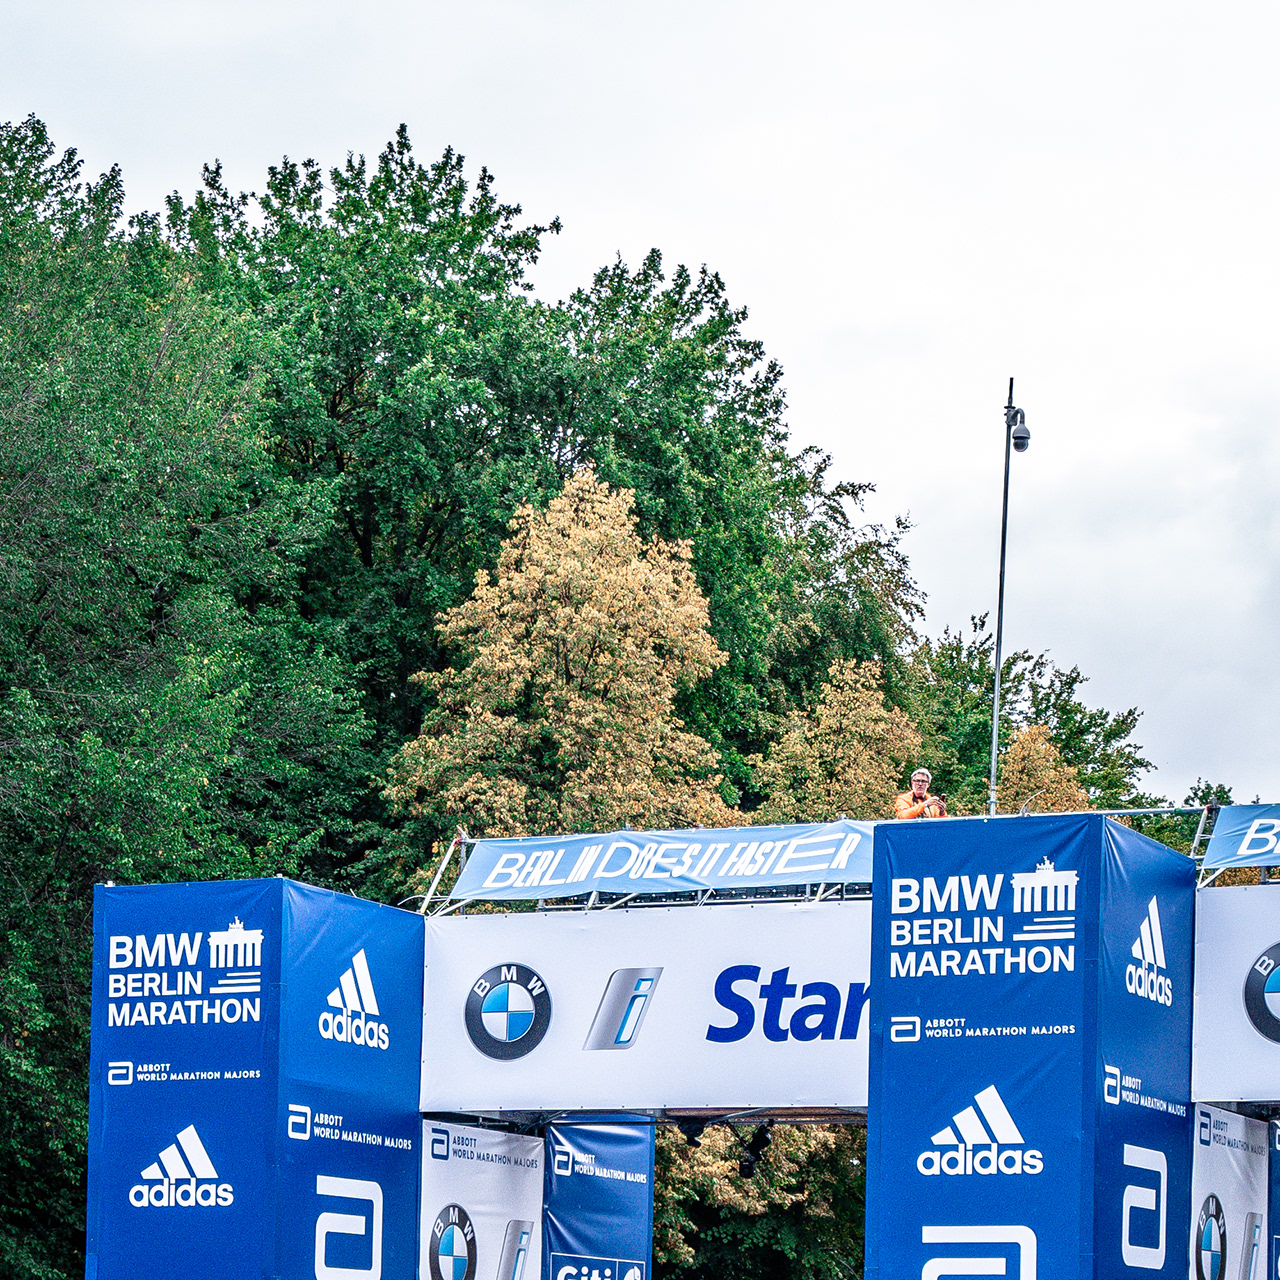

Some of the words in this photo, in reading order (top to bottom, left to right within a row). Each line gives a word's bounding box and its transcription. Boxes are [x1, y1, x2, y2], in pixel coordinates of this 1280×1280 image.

[482, 845, 604, 888] BERLIN
[594, 841, 701, 880] DOES
[693, 841, 733, 877] IT
[718, 832, 862, 877] FASTER
[891, 873, 1004, 914] BMW
[890, 916, 1003, 946] BERLIN
[108, 932, 203, 969] BMW
[890, 945, 1075, 978] MARATHON
[108, 971, 202, 998] BERLIN
[1125, 959, 1173, 1007] adidas
[108, 998, 261, 1027] MARATHON
[705, 964, 871, 1043] Star
[318, 1008, 390, 1050] adidas
[925, 1018, 966, 1028] ABBOTT
[925, 1028, 962, 1038] WORLD
[965, 1026, 1027, 1037] MARATHON
[1031, 1024, 1076, 1035] MAJORS
[136, 1063, 171, 1073] ABBOTT
[136, 1072, 168, 1081] WORLD
[170, 1070, 221, 1081] MARATHON
[224, 1070, 261, 1080] MAJORS
[1122, 1075, 1142, 1091] ABBOTT
[1121, 1089, 1140, 1105] WORLD
[1140, 1094, 1167, 1112] MARATHON
[1168, 1101, 1187, 1117] MAJORS
[314, 1112, 343, 1127] ABBOTT
[313, 1126, 340, 1141] WORLD
[341, 1130, 383, 1147] MARATHON
[384, 1136, 412, 1150] MAJORS
[452, 1136, 477, 1149] ABBOTT
[452, 1148, 474, 1160] WORLD
[476, 1151, 512, 1166] MARATHON
[513, 1157, 538, 1169] MAJORS
[917, 1143, 1044, 1176] adidas
[574, 1164, 595, 1176] WORLD
[595, 1166, 626, 1180] MARATHON
[626, 1172, 647, 1184] MAJORS
[128, 1177, 235, 1207] adidas
